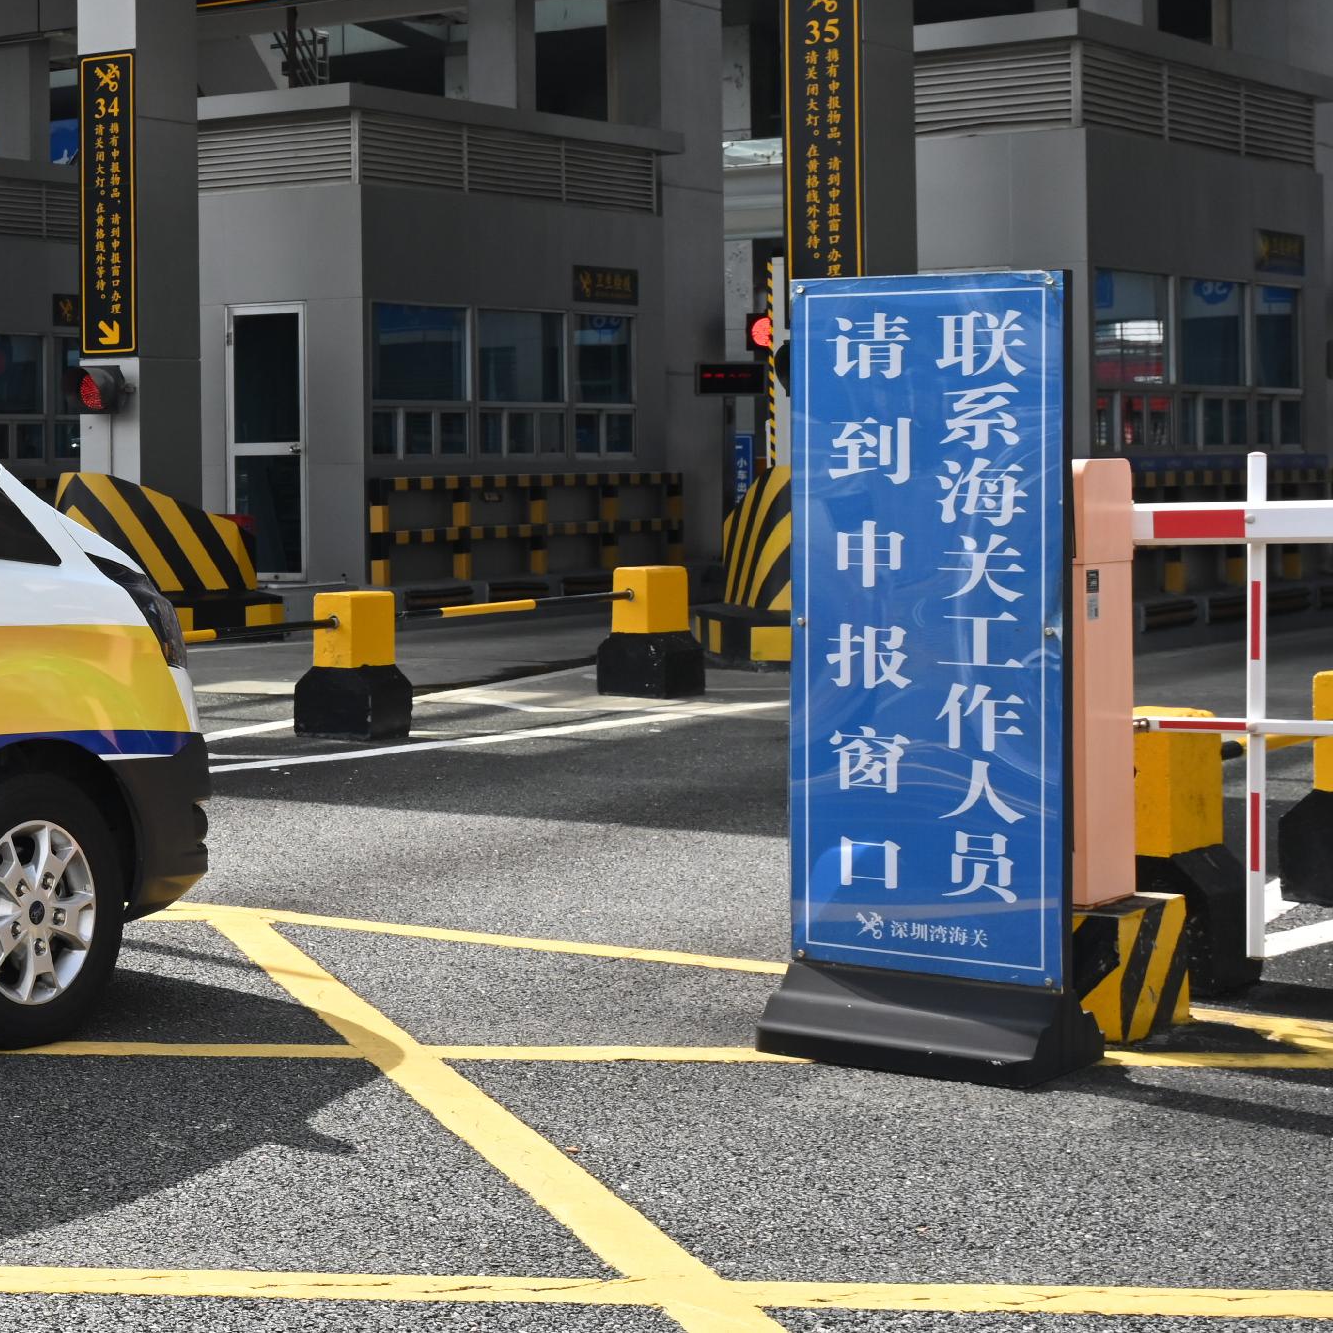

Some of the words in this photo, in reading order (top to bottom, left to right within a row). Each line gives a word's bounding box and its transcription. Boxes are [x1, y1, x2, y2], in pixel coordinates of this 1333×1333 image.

[804, 18, 840, 45] 35
[94, 96, 120, 119] 34
[826, 312, 911, 890] 请到申报窗口
[935, 309, 1030, 904] 联系海关工作人员
[890, 920, 989, 948] 深圳湾海关
